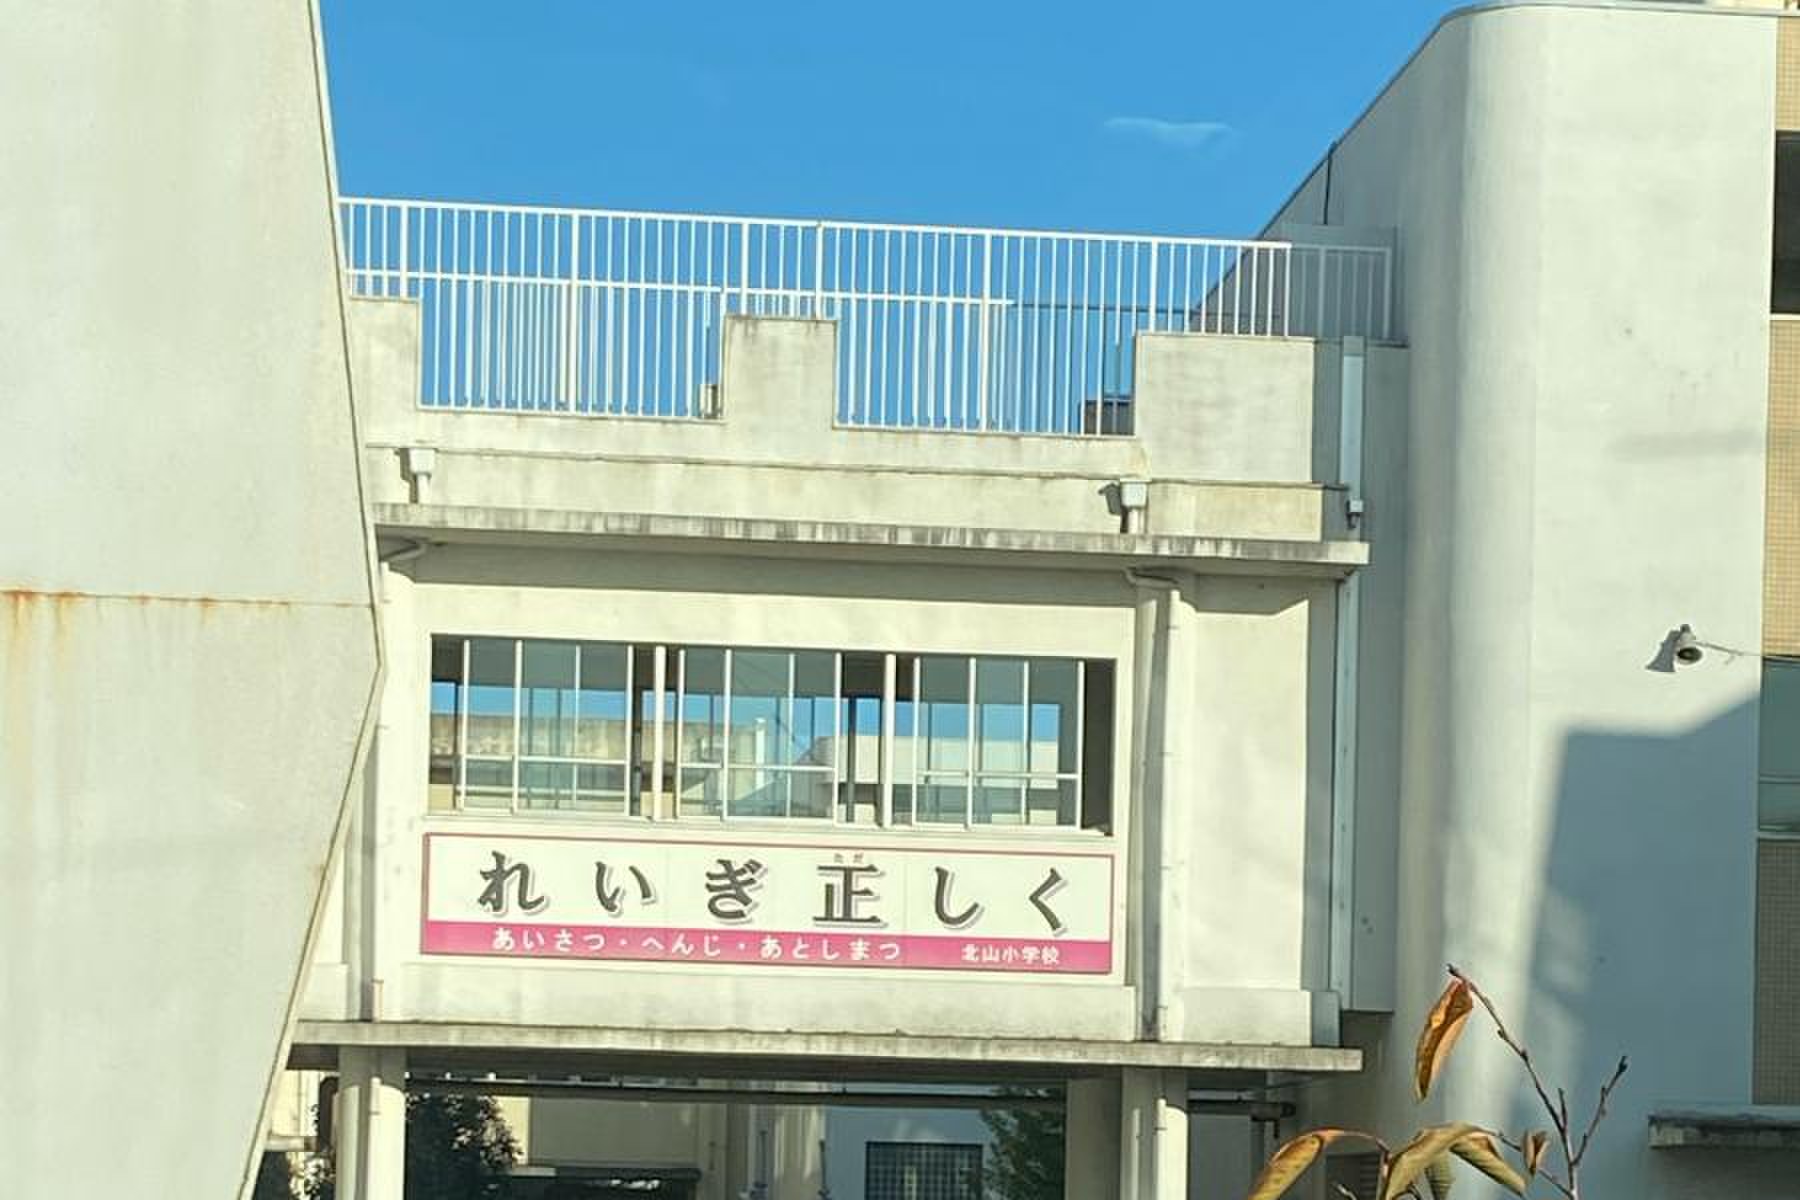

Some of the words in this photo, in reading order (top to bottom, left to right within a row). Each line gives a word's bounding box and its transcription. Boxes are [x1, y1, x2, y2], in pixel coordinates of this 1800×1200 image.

[478, 851, 1064, 933] れいぎ正しく
[962, 944, 1059, 965] 北山小学校
